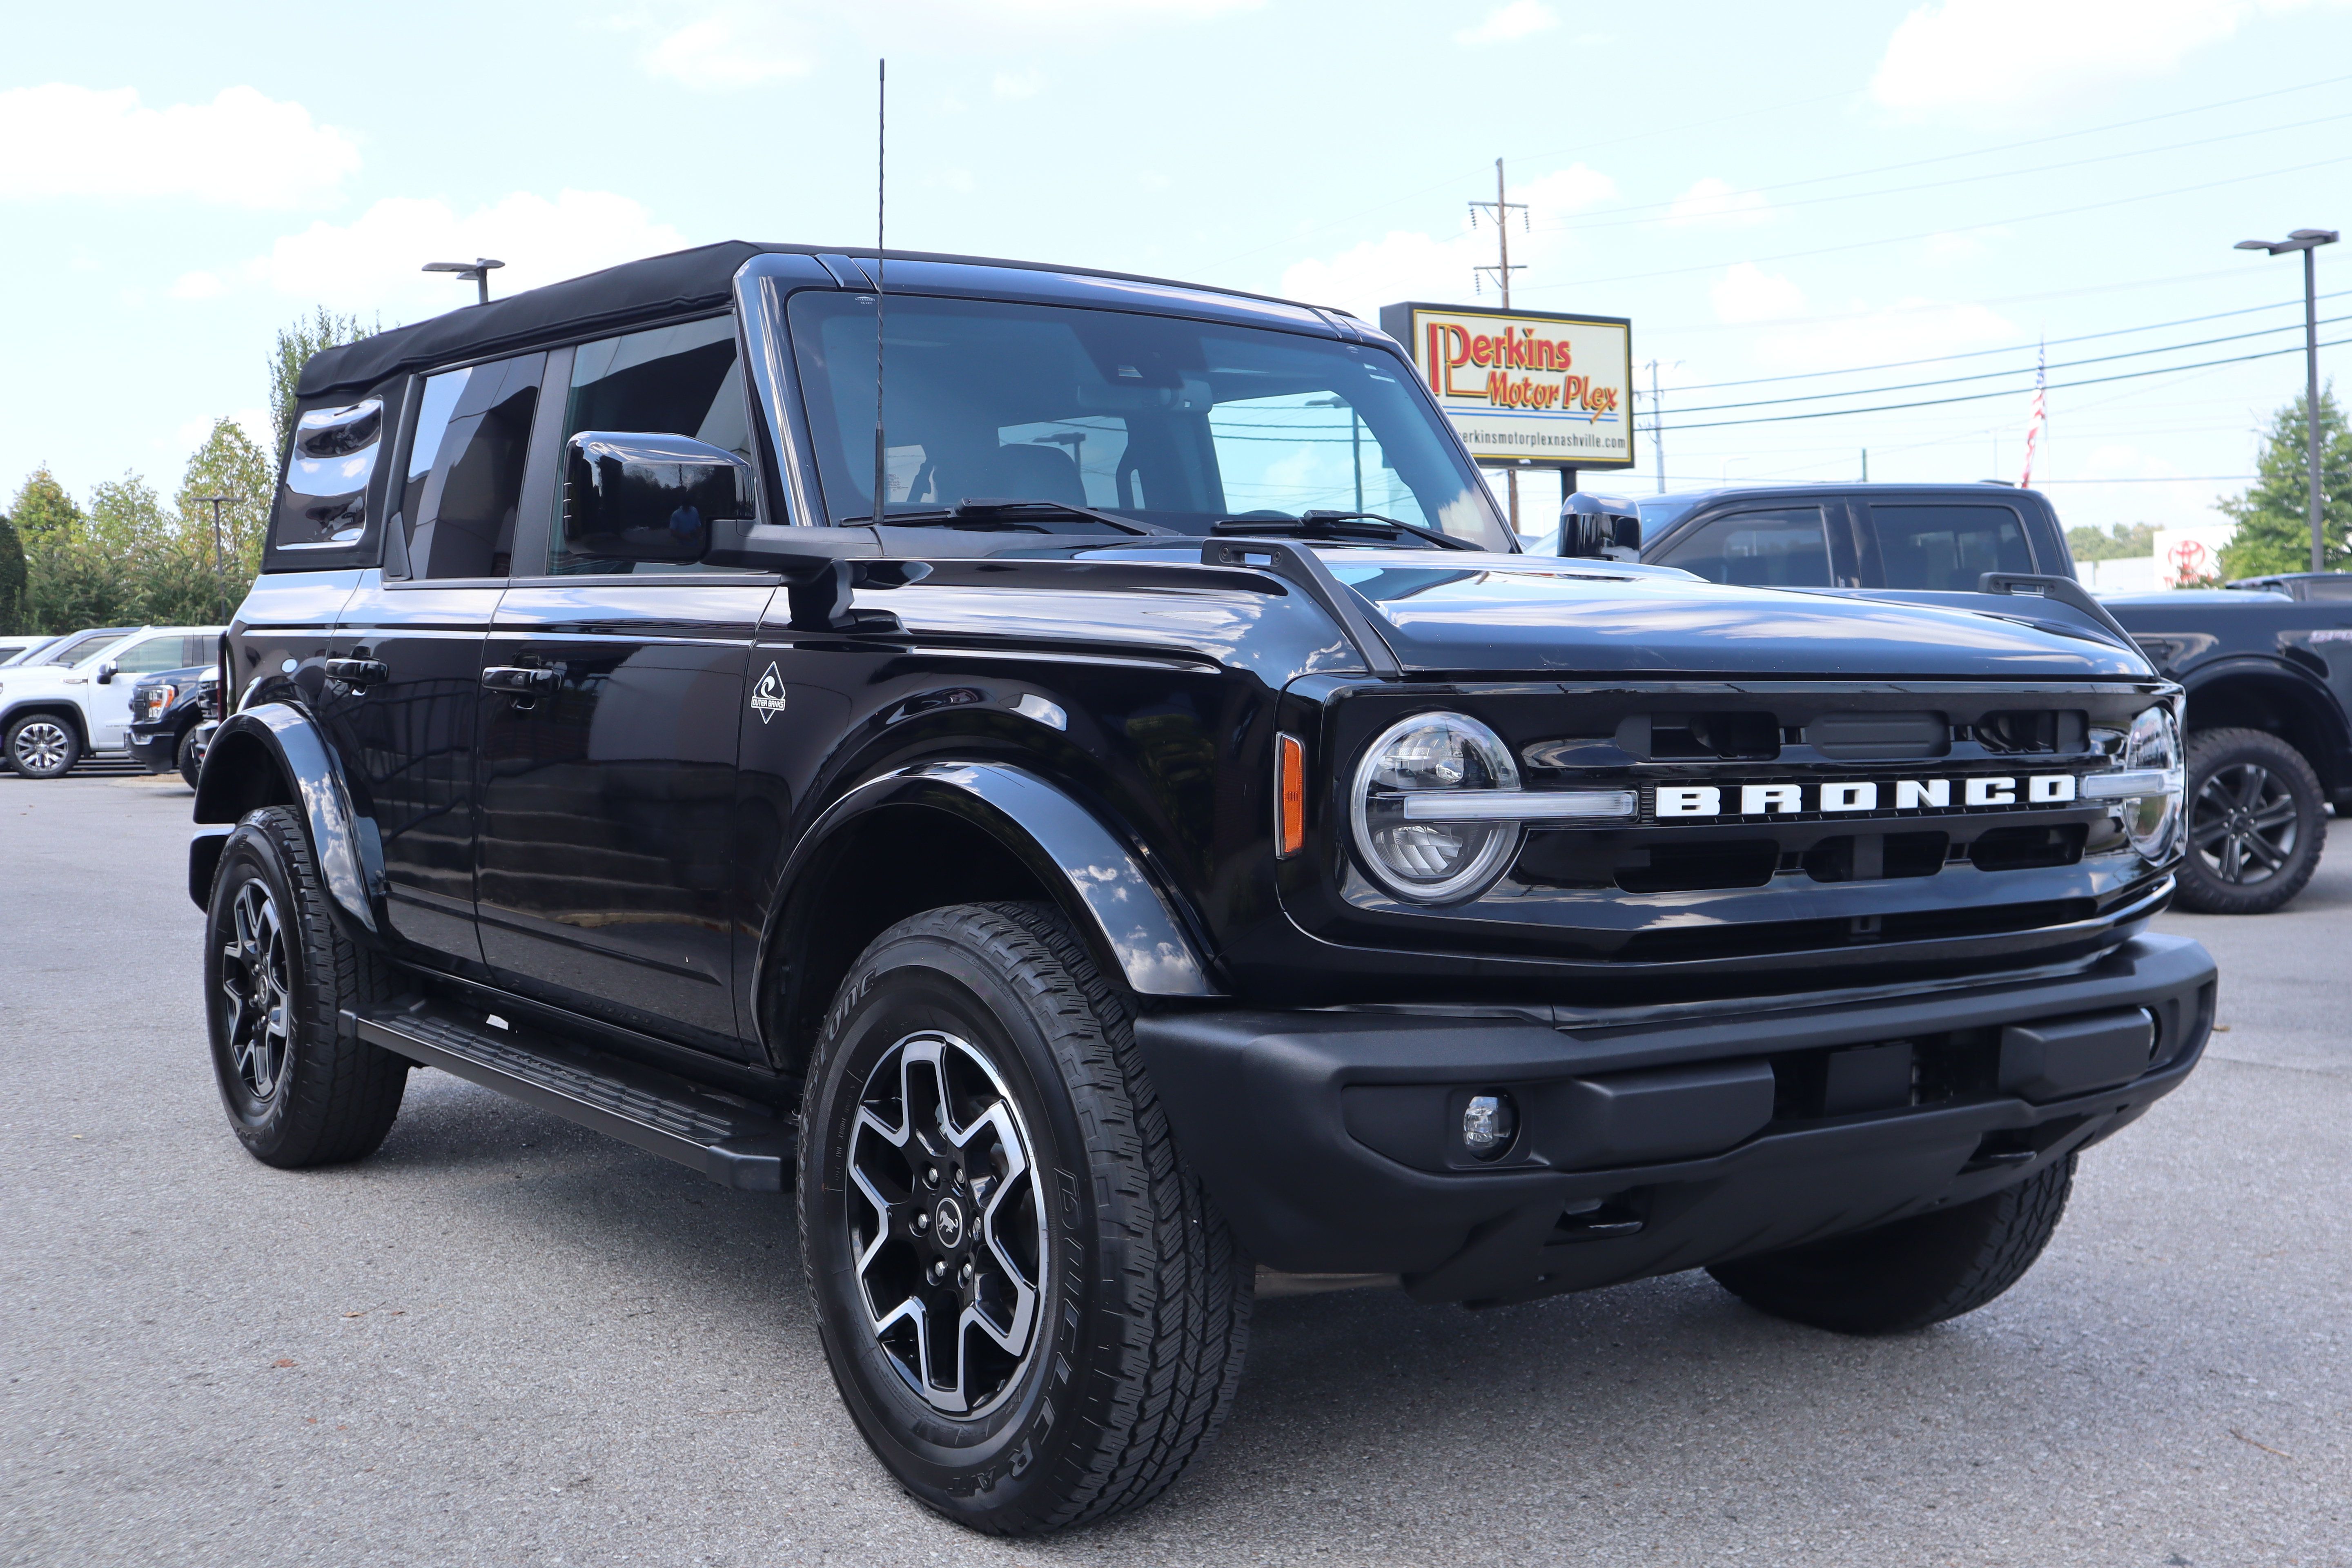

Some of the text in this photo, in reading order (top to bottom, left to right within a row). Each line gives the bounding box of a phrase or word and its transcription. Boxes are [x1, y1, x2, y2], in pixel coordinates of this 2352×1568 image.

[1428, 322, 1572, 395] Perkins
[1487, 370, 1618, 423] Motor Plex
[1459, 429, 1626, 449] erkinsmotorplexnashville.com
[1657, 775, 2076, 817] BRONCO
